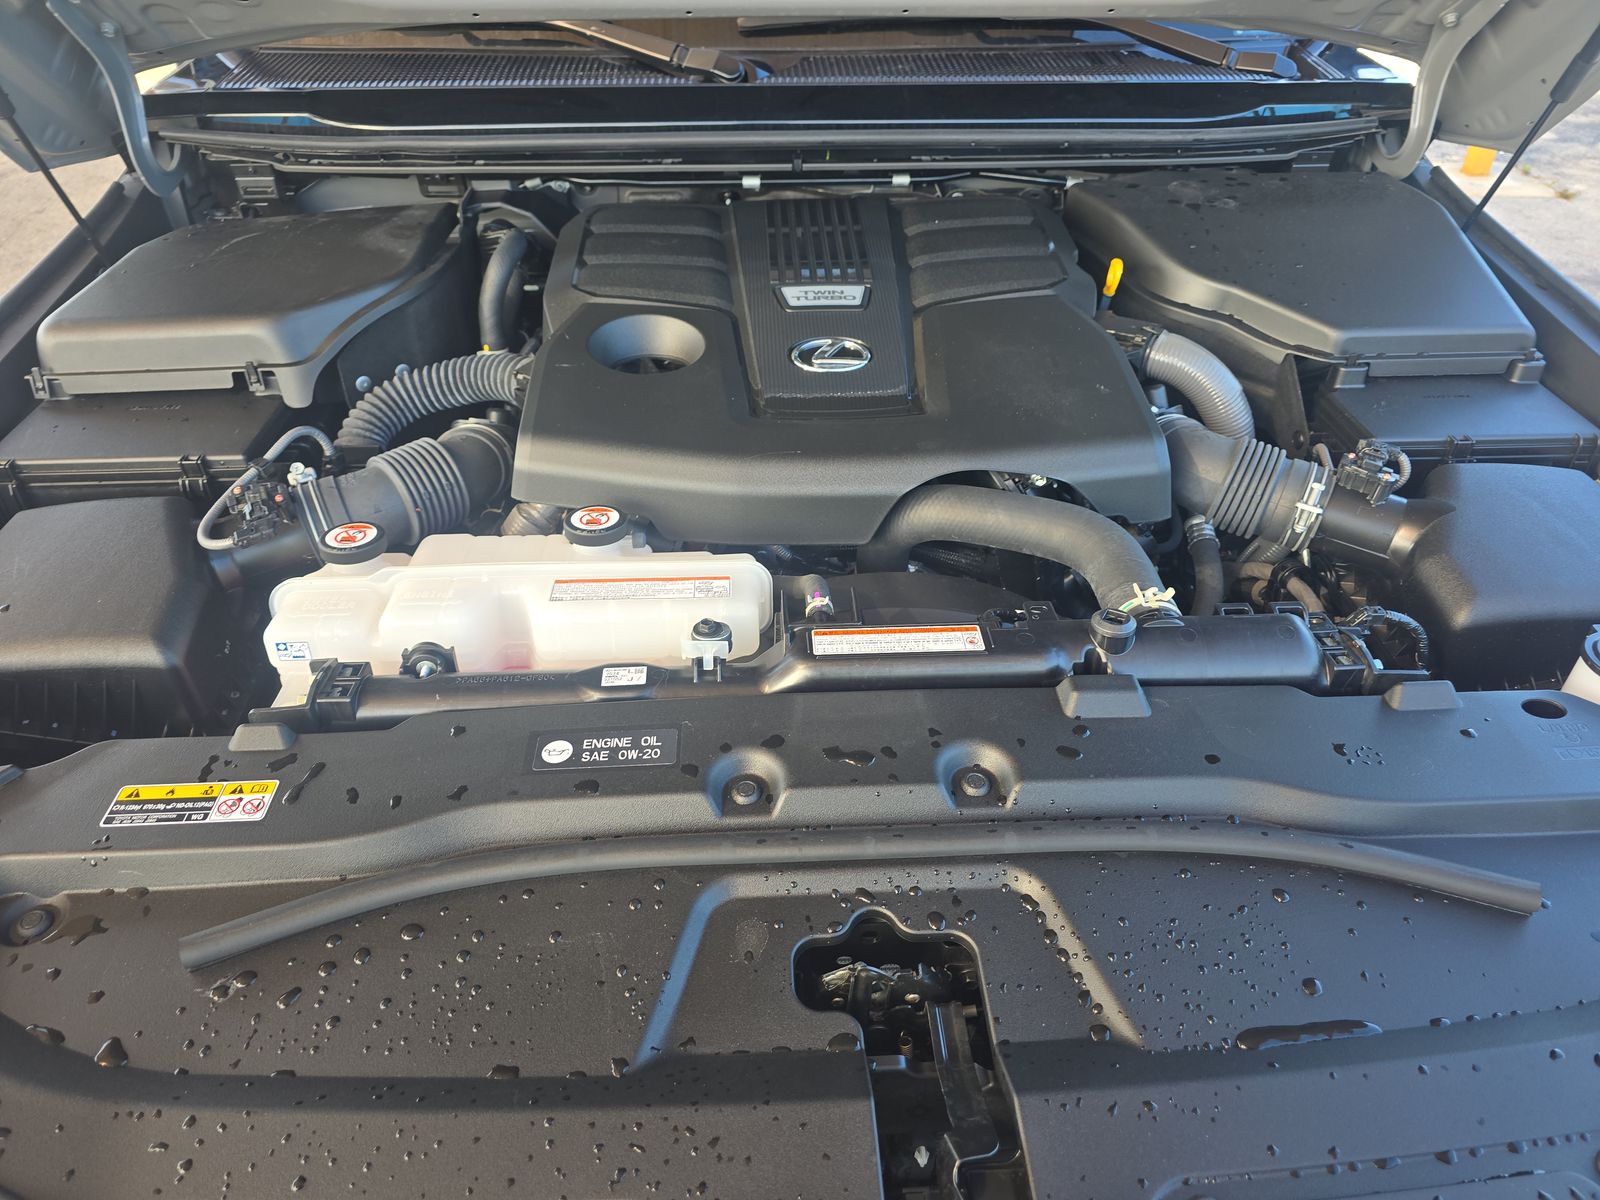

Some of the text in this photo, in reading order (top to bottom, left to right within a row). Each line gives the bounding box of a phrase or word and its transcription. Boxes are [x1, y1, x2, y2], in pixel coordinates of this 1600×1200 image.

[582, 735, 662, 749] ENGINE OIL
[581, 748, 661, 762] SAE 0W-20
